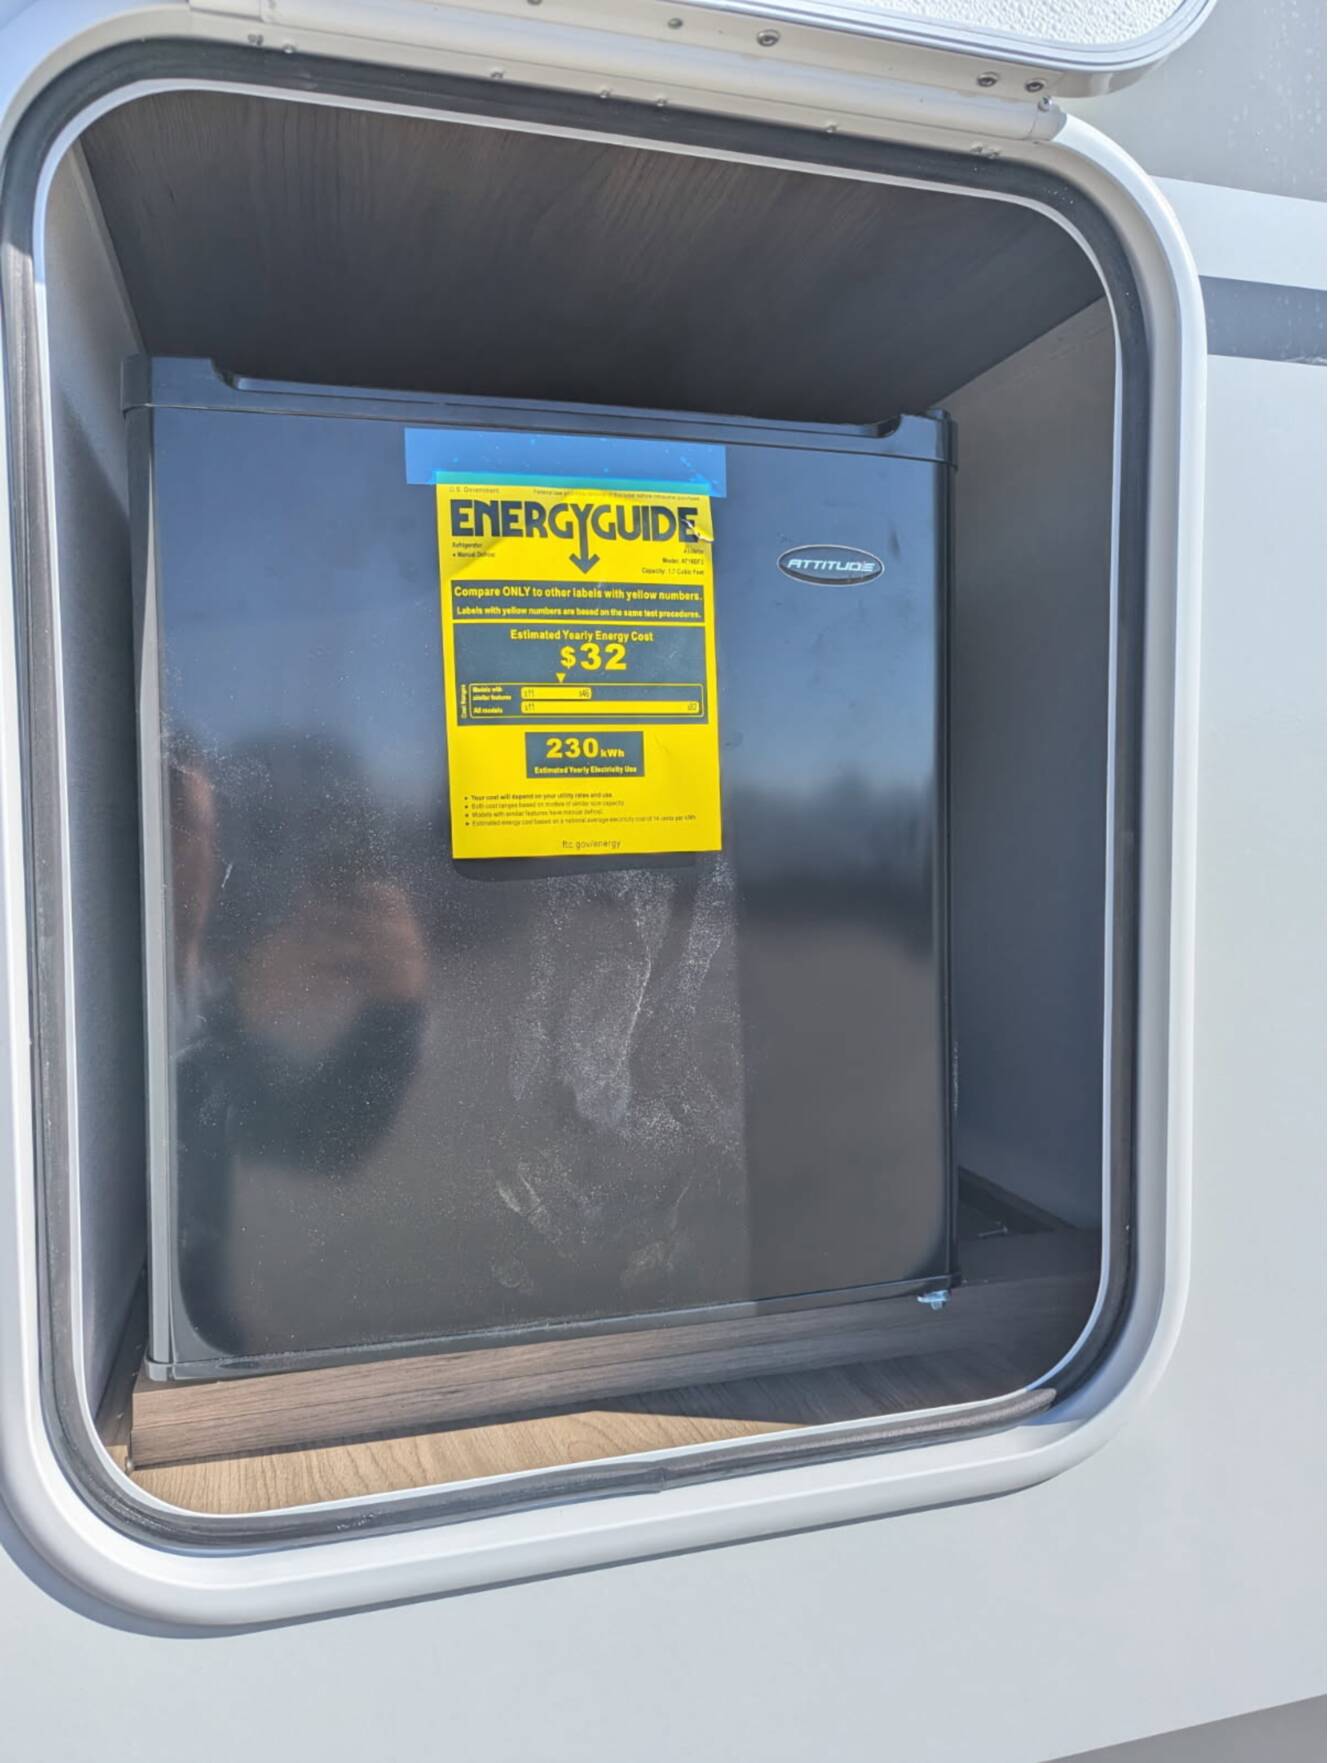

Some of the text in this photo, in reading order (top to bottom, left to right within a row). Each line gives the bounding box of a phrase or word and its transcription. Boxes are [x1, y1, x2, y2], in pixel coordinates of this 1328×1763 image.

[450, 499, 699, 543] ENERGYGUIDE
[786, 558, 876, 572] ATTITUDE
[454, 586, 703, 602] Compare ONLY to other labels with yellow numbers.
[457, 606, 483, 615] Labels
[484, 606, 501, 615] with
[502, 606, 527, 616] yellow
[528, 606, 561, 615] numbers
[563, 608, 575, 616] are
[576, 608, 599, 616] based
[610, 608, 622, 617] the
[644, 609, 658, 618] test
[659, 610, 702, 619] procedures.
[510, 629, 654, 643] Estimated Yearly Energy Cost
[560, 642, 627, 670] $32
[545, 737, 625, 758] 230 kWh
[534, 765, 637, 775] Estimated Yearly Electricity Use
